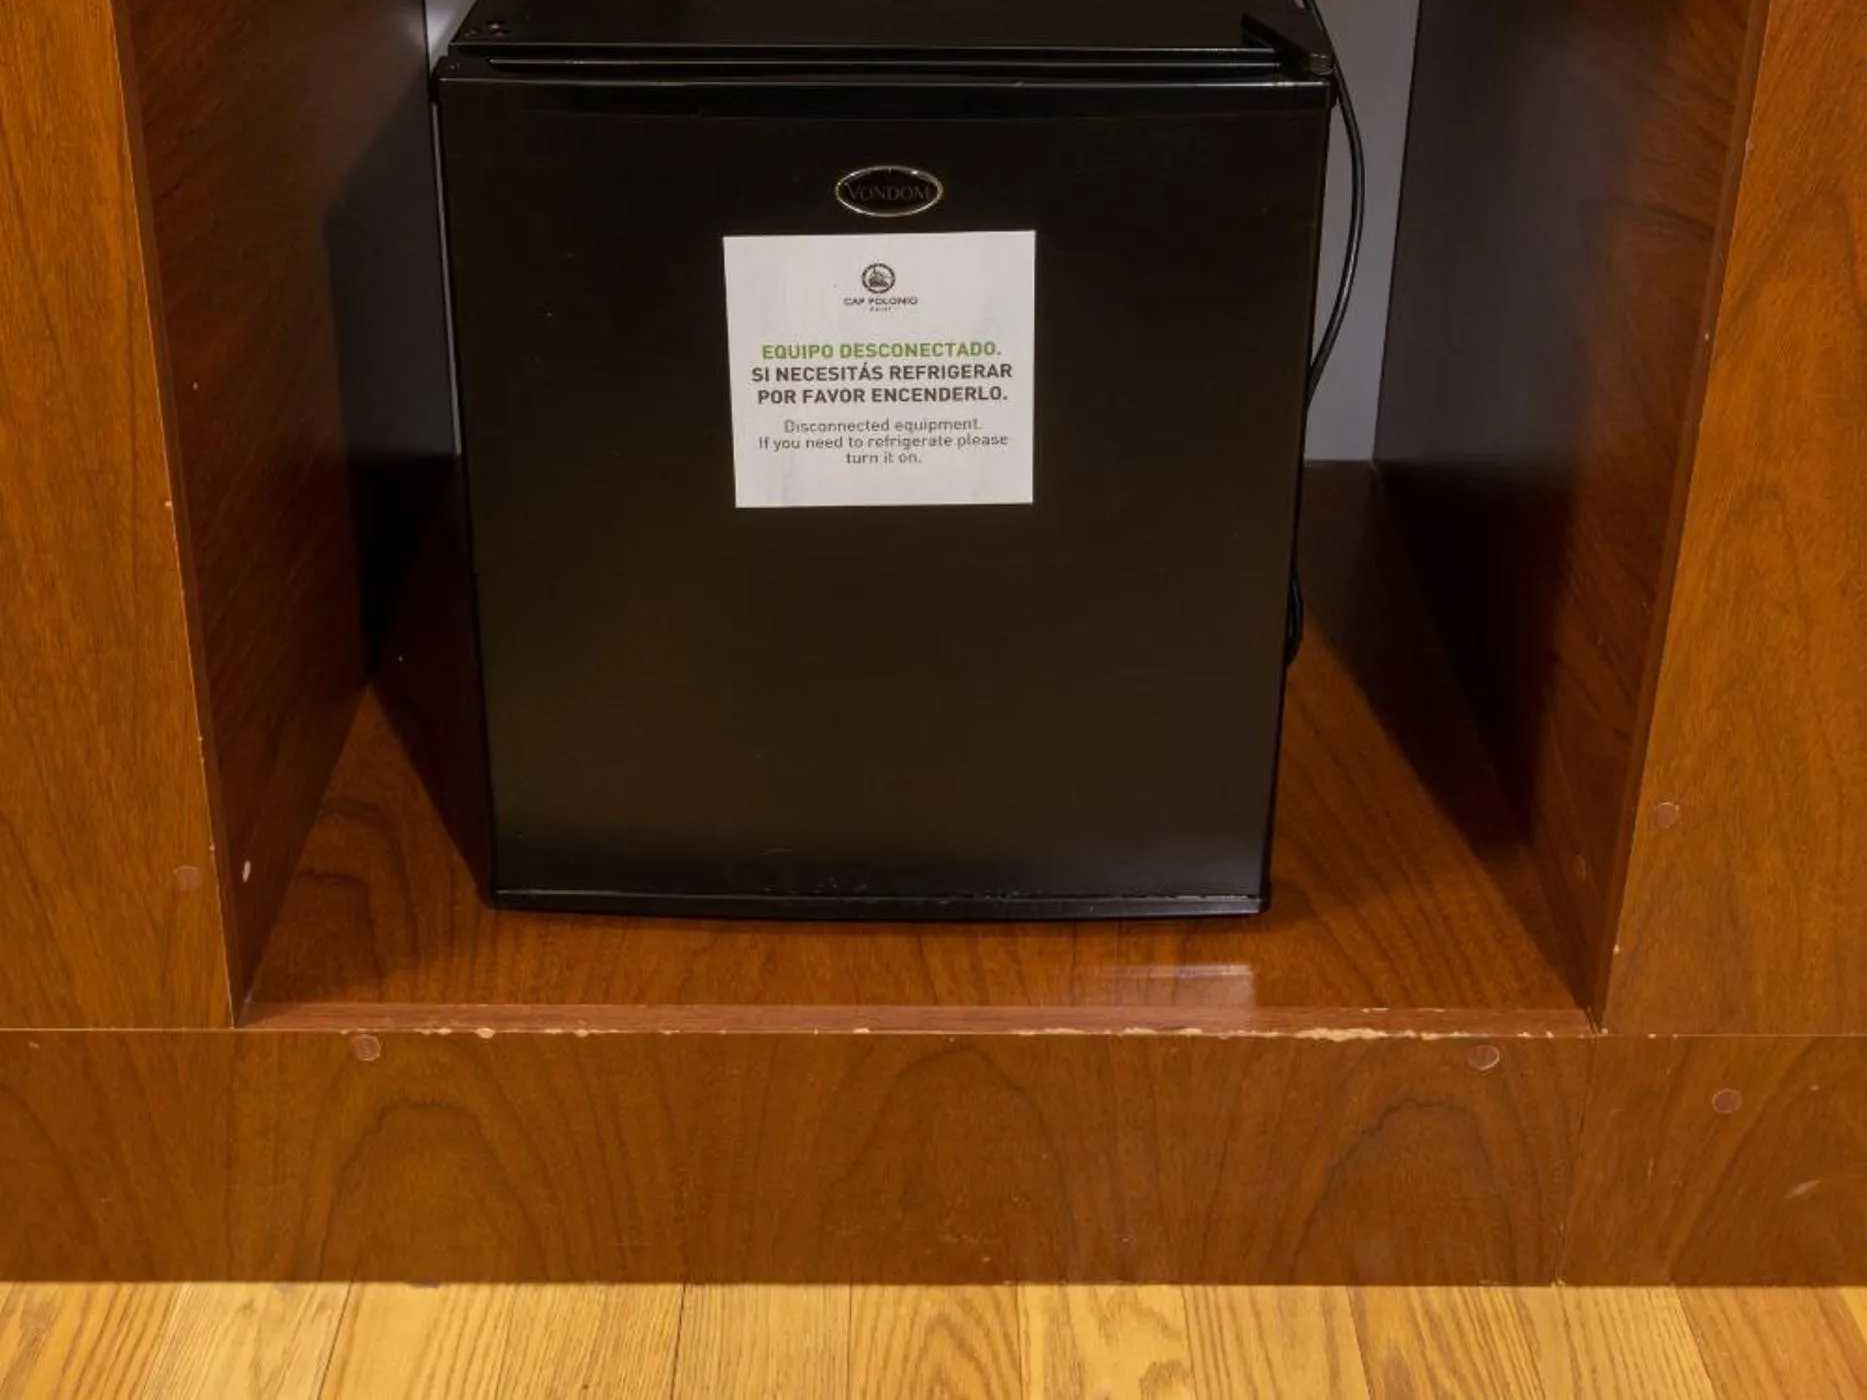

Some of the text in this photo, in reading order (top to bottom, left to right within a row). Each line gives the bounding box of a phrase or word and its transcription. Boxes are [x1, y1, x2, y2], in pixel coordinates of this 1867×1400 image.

[843, 182, 930, 201] VONDOM
[762, 341, 1002, 360] EQUIPO DESCONECTADO.
[751, 362, 1013, 382] SI NECESITÁS REFRIGERAR
[758, 385, 1008, 404] POR FAVOR ENCENDERLO.
[784, 418, 890, 433] Disconnected
[759, 433, 1009, 452] If you need to refrigerate please
[847, 451, 922, 464] turn it on.
